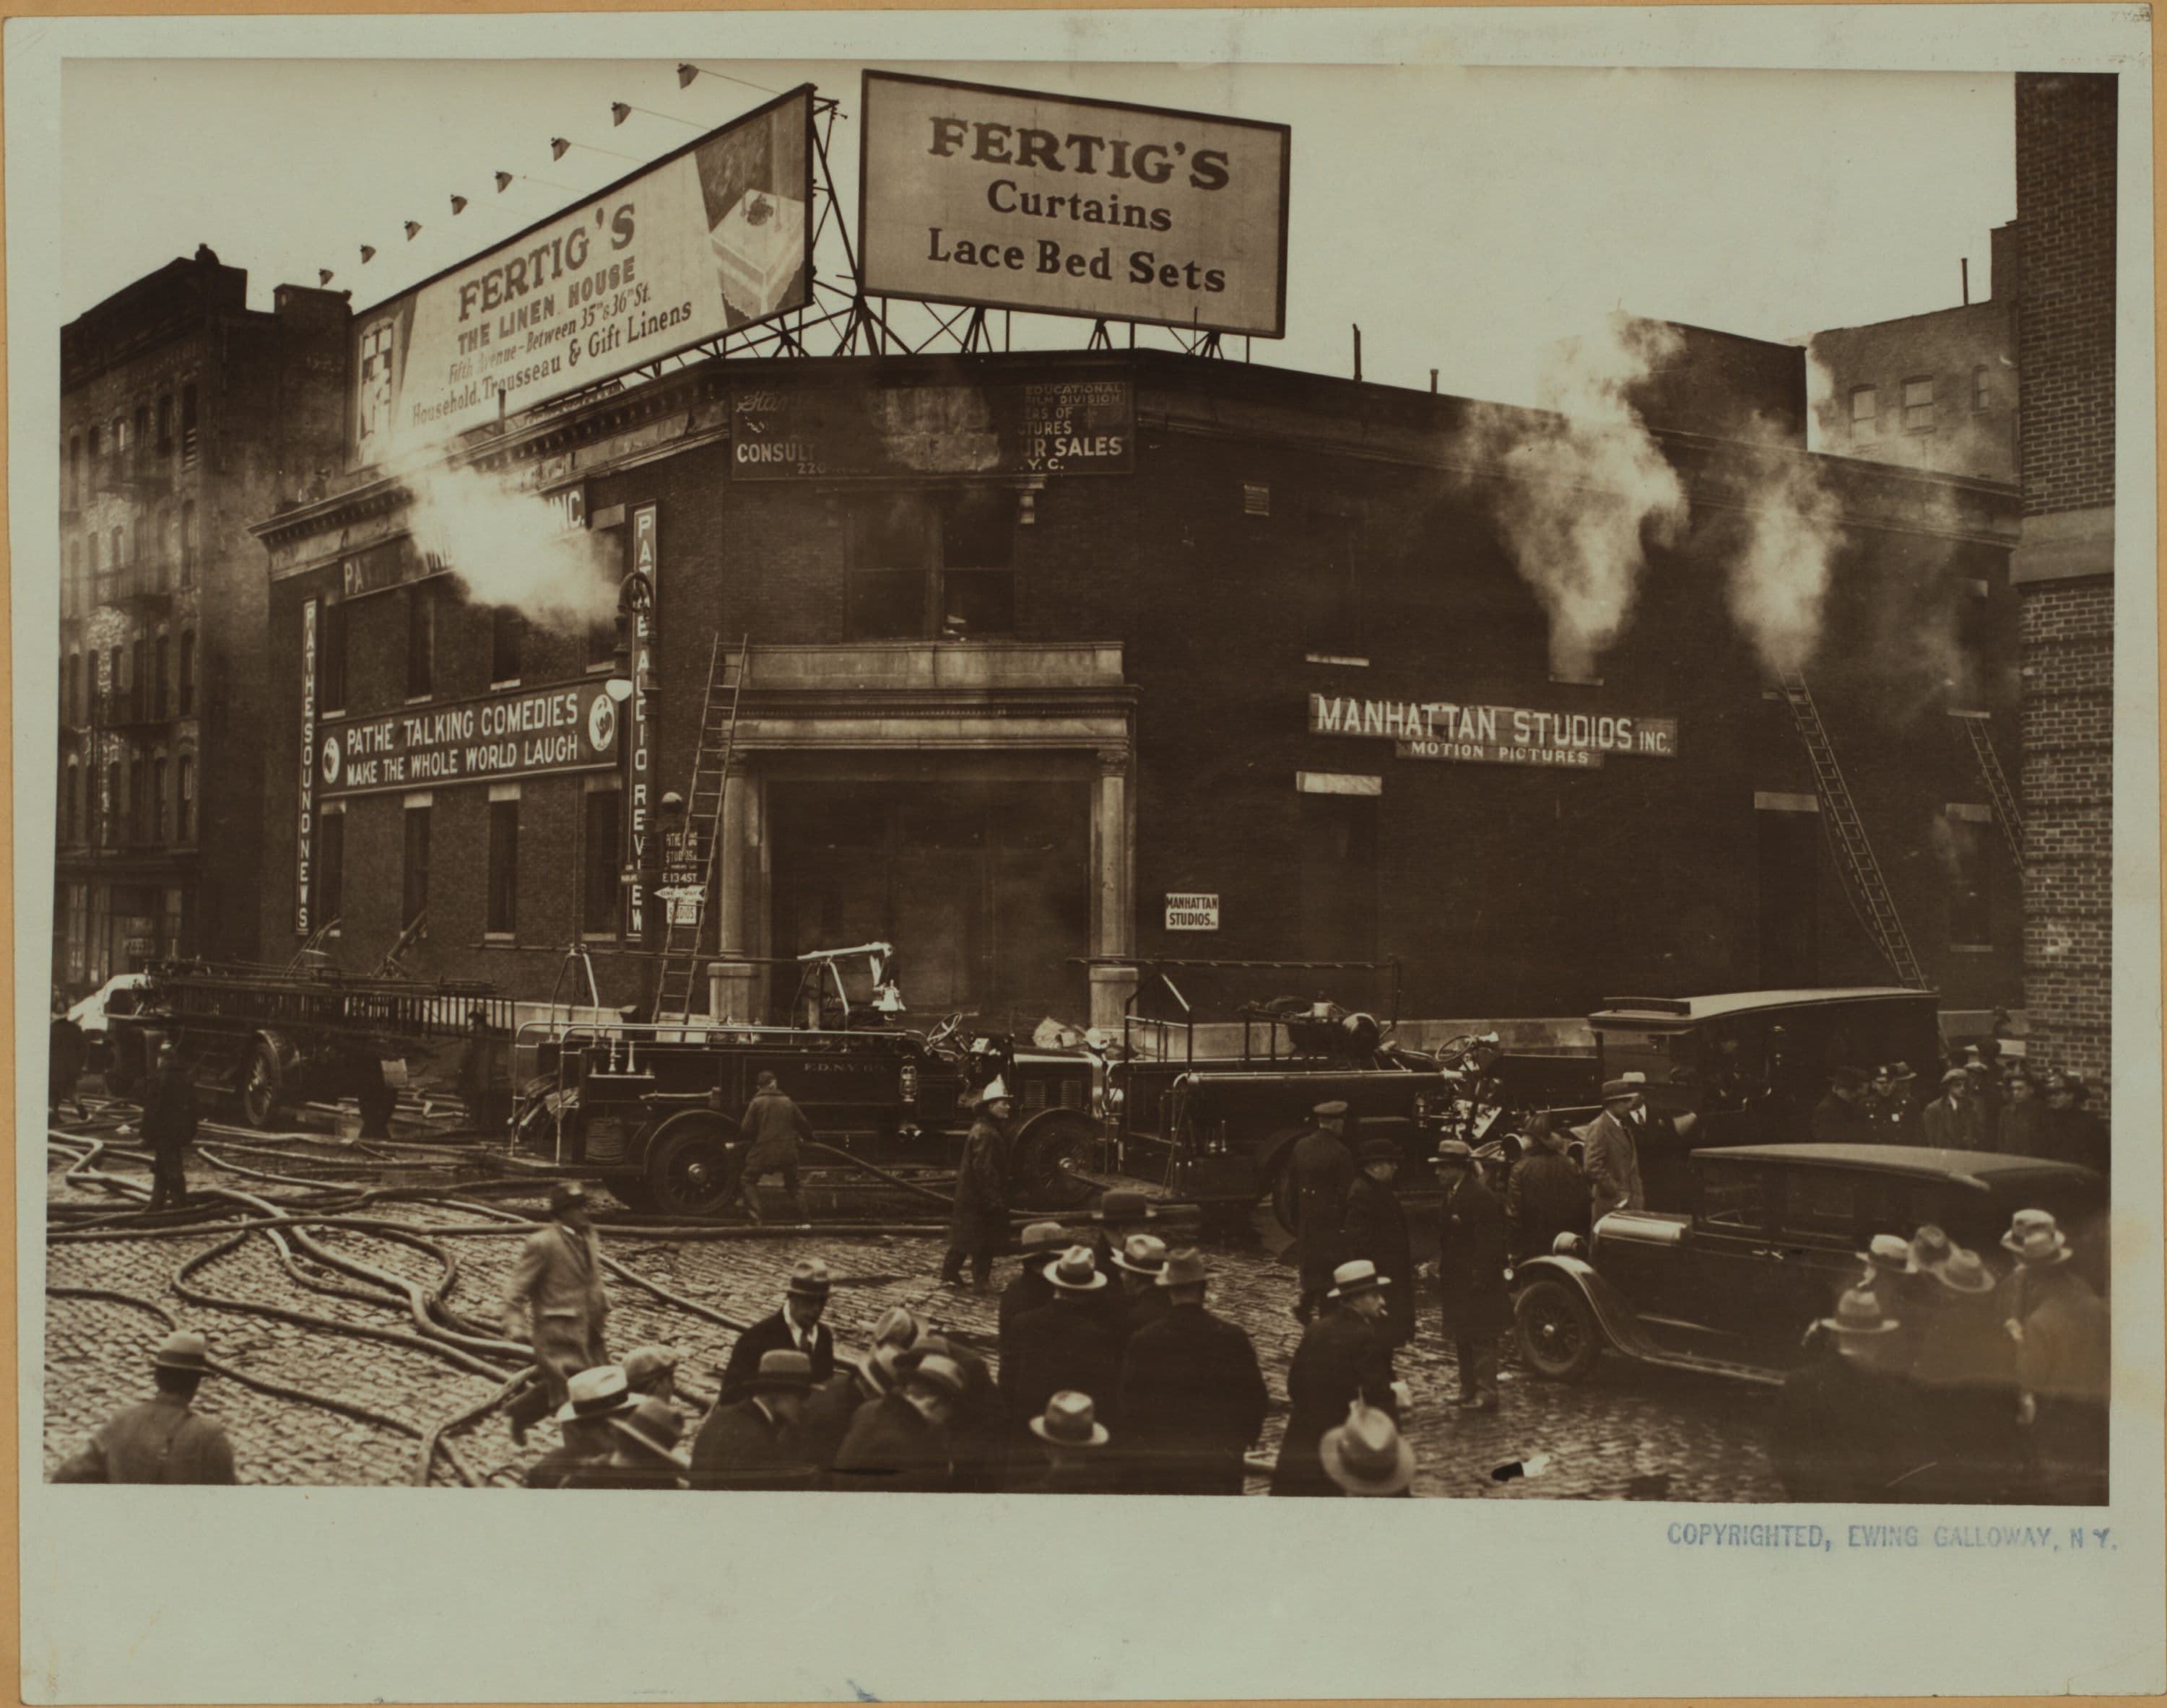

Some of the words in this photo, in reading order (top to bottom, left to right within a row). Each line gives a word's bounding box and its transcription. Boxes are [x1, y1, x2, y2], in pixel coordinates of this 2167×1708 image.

[928, 116, 1230, 191] FERTIG'S
[988, 179, 1172, 232] Curtains
[459, 203, 635, 322] FERTIG'S
[928, 227, 1024, 270] Lace
[1036, 240, 1112, 281] Bed
[1129, 251, 1225, 292] Sets
[458, 322, 490, 355] THE
[499, 294, 554, 339] LINEN
[568, 256, 635, 308] HOUSE
[448, 360, 473, 384] Fifth
[482, 356, 560, 401] Trousseau
[569, 339, 581, 367] &
[589, 323, 620, 357] Gift
[627, 301, 692, 344] Linens
[1025, 384, 1121, 395] EDUCATIONAL
[1056, 406, 1074, 419] OF
[1060, 393, 1124, 404] DIVISION
[1054, 436, 1123, 456] SALES
[304, 606, 316, 717] PATHE
[404, 710, 474, 746] TALKING
[482, 693, 578, 736] COMEDIES
[1317, 696, 1496, 741] MANHATTAN
[1514, 710, 1632, 749] STUDIOS
[1639, 731, 1672, 753] INC.
[301, 723, 313, 833] SOUND
[347, 760, 378, 785] MAKE
[383, 757, 404, 781] THE
[412, 749, 458, 777] WHOLE
[466, 742, 517, 772] WORLD
[524, 733, 578, 765] LAUGH
[1411, 741, 1484, 758] MOTION
[1498, 747, 1589, 764] PICTURES
[299, 840, 310, 927] NEWS
[1165, 897, 1217, 909] MANHATTAN
[1170, 912, 1210, 925] STUDIOS
